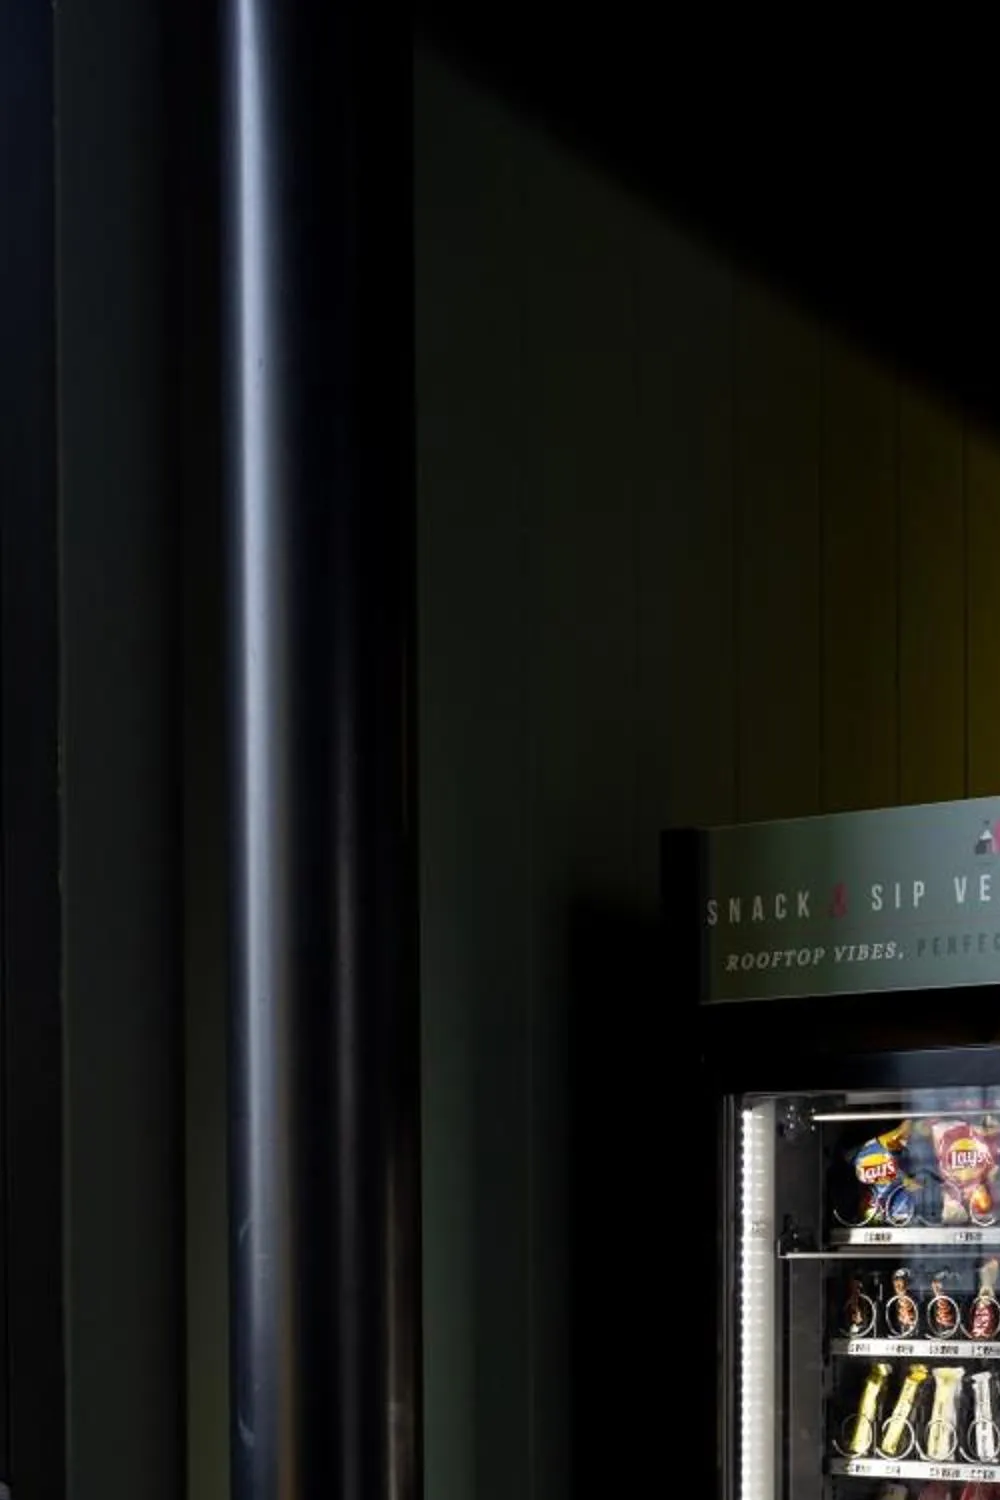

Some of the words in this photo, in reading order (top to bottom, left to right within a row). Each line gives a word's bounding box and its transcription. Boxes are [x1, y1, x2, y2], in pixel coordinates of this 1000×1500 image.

[706, 889, 810, 926] SNACK
[871, 880, 925, 911] SIP
[725, 947, 826, 972] ROOFTOP
